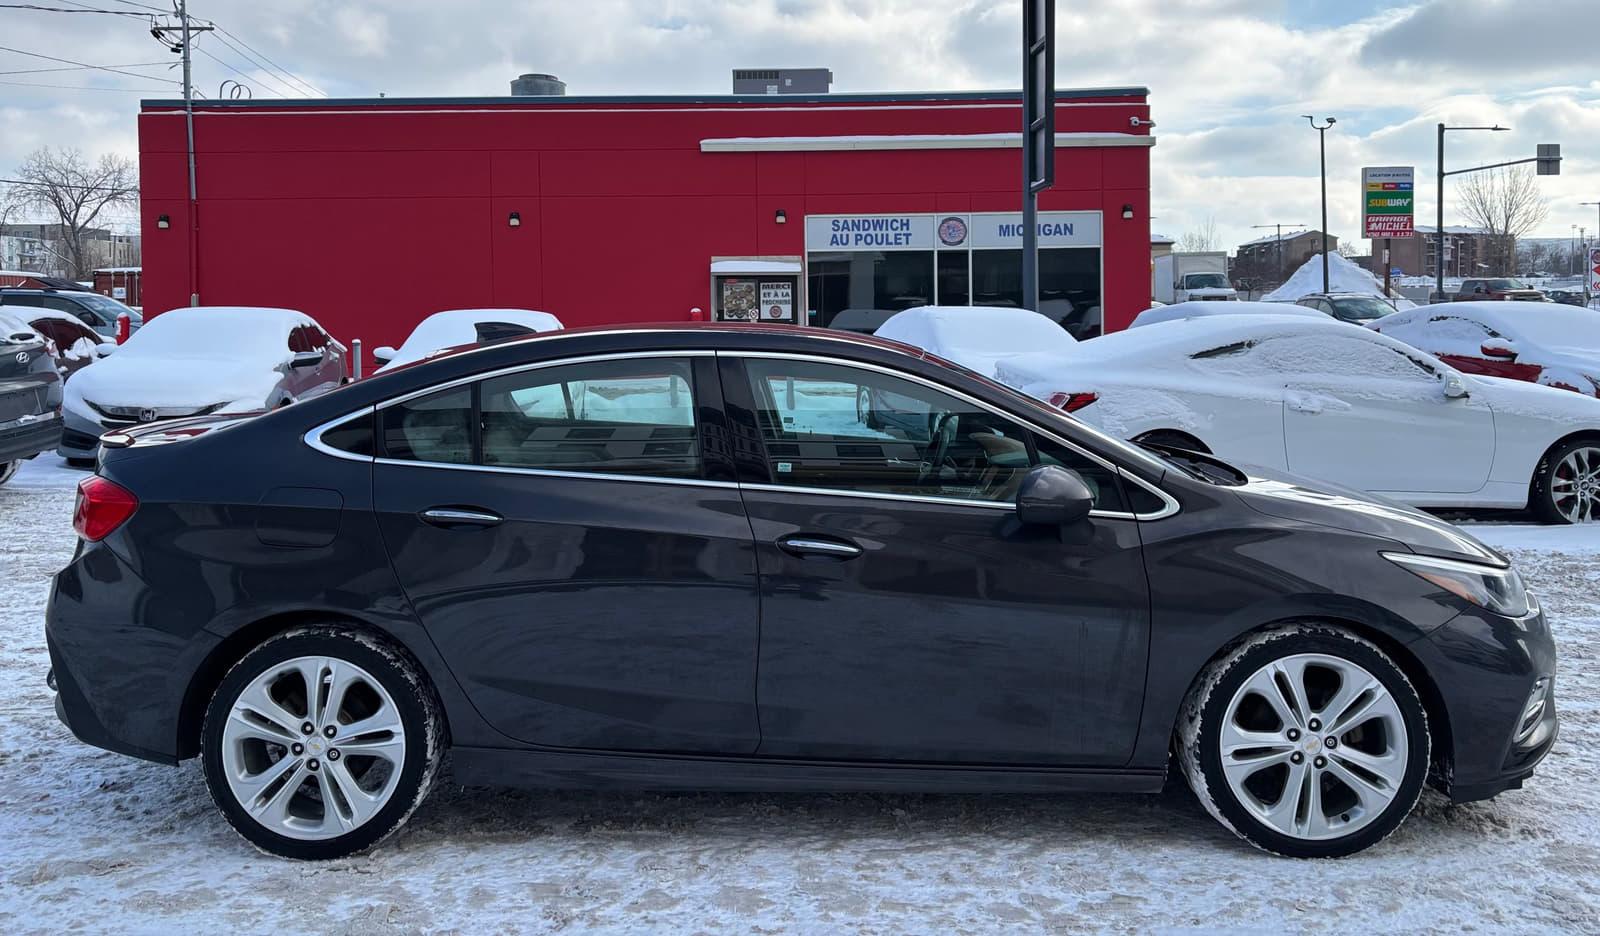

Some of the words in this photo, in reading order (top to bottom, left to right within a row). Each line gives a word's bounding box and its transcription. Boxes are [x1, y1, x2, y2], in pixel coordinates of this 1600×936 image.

[1368, 198, 1411, 207] SUBWAY
[831, 218, 910, 232] SANDWICH
[998, 223, 1074, 237] MICIGAN
[1367, 222, 1412, 231] MICHEL
[829, 233, 850, 246] AU
[854, 233, 912, 246] POULET
